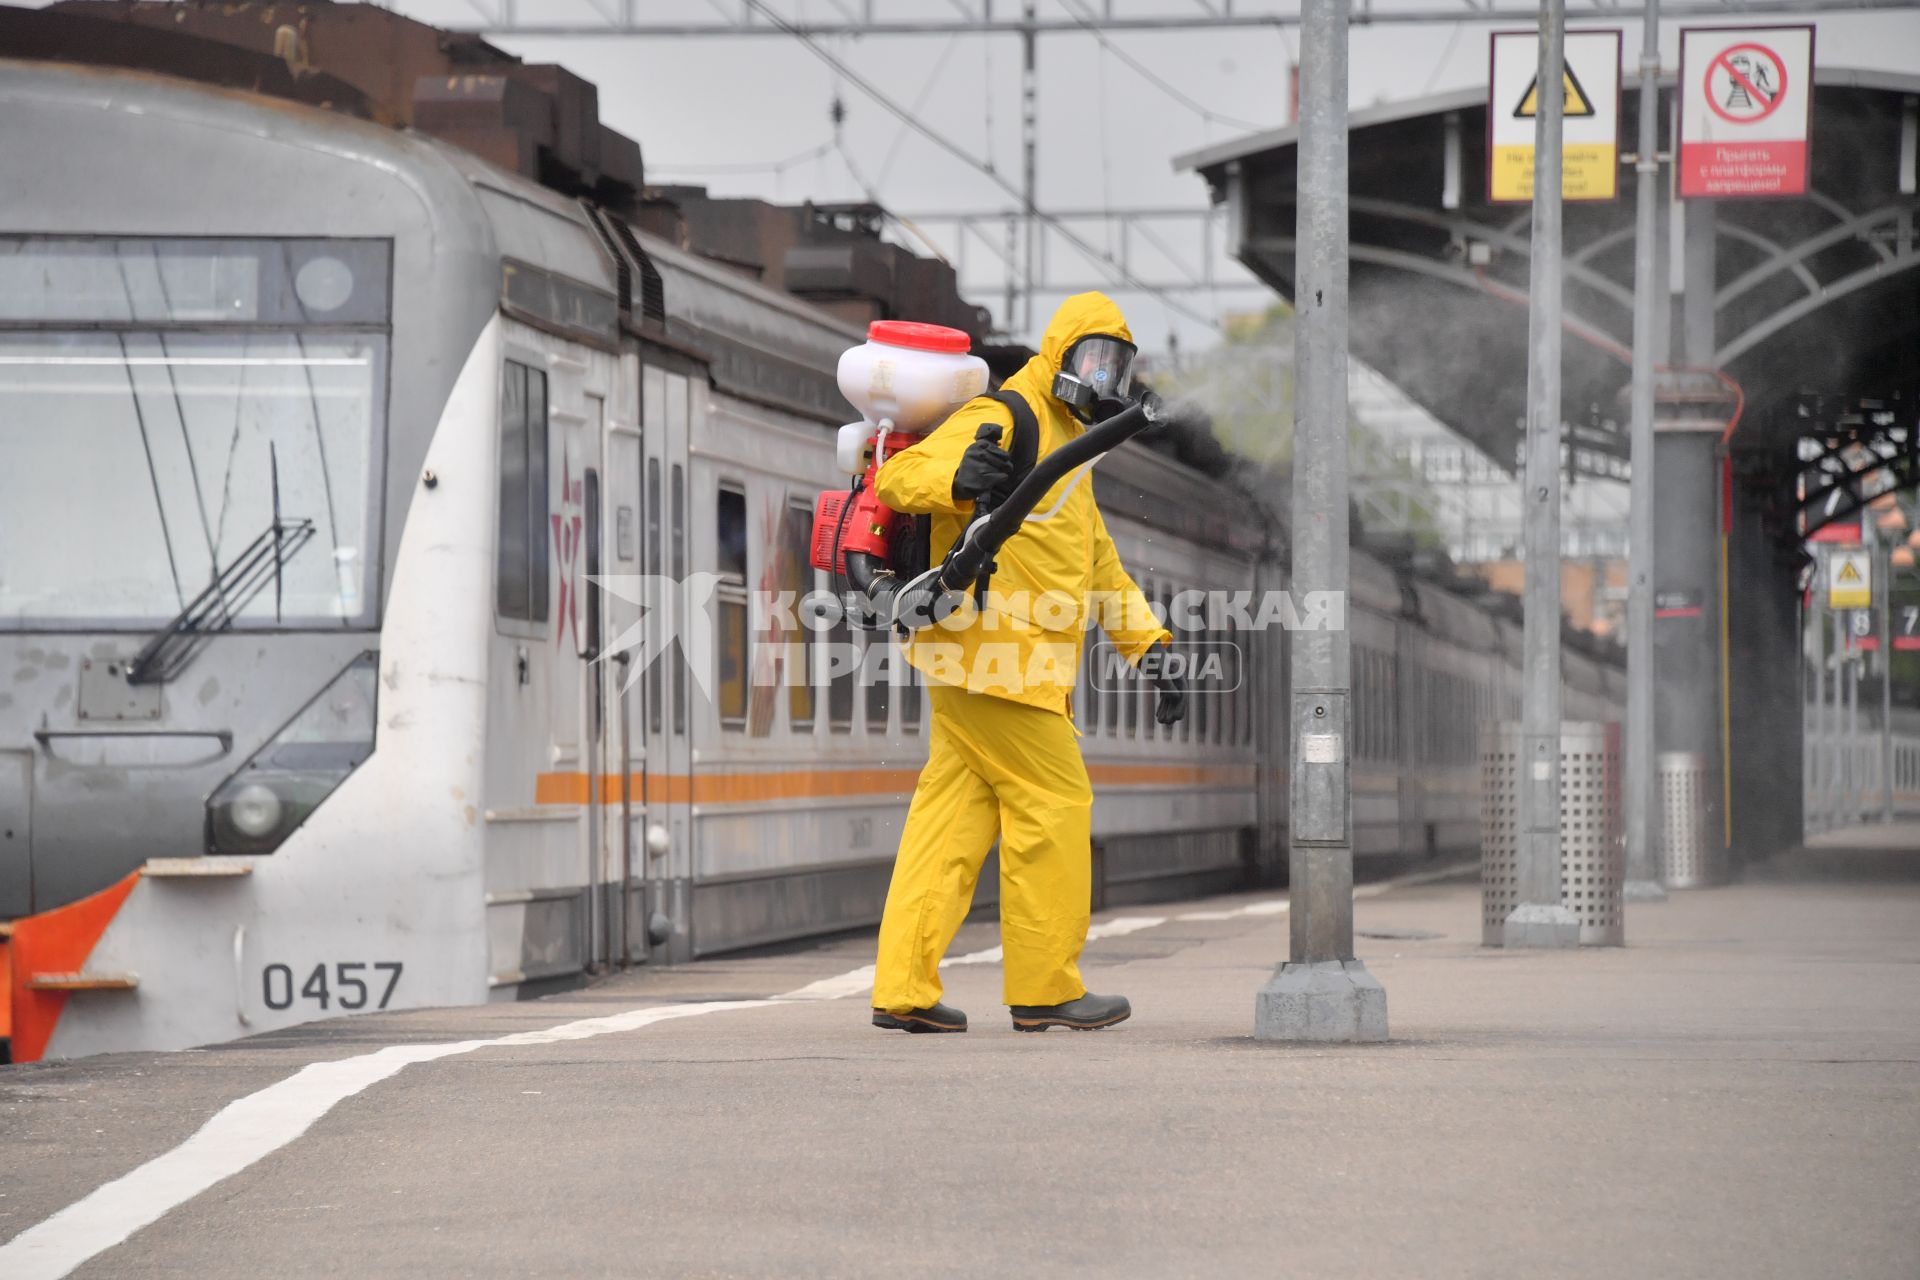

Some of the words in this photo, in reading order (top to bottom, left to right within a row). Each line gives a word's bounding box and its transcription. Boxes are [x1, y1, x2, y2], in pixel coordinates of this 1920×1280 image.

[1716, 146, 1770, 163] Прыгать
[1700, 165, 1709, 177] с
[1711, 164, 1787, 178] платформы
[1706, 177, 1781, 193] запрещено!
[1853, 610, 1870, 636] 8
[1903, 605, 1919, 635] 7
[263, 962, 403, 1010] 0457
